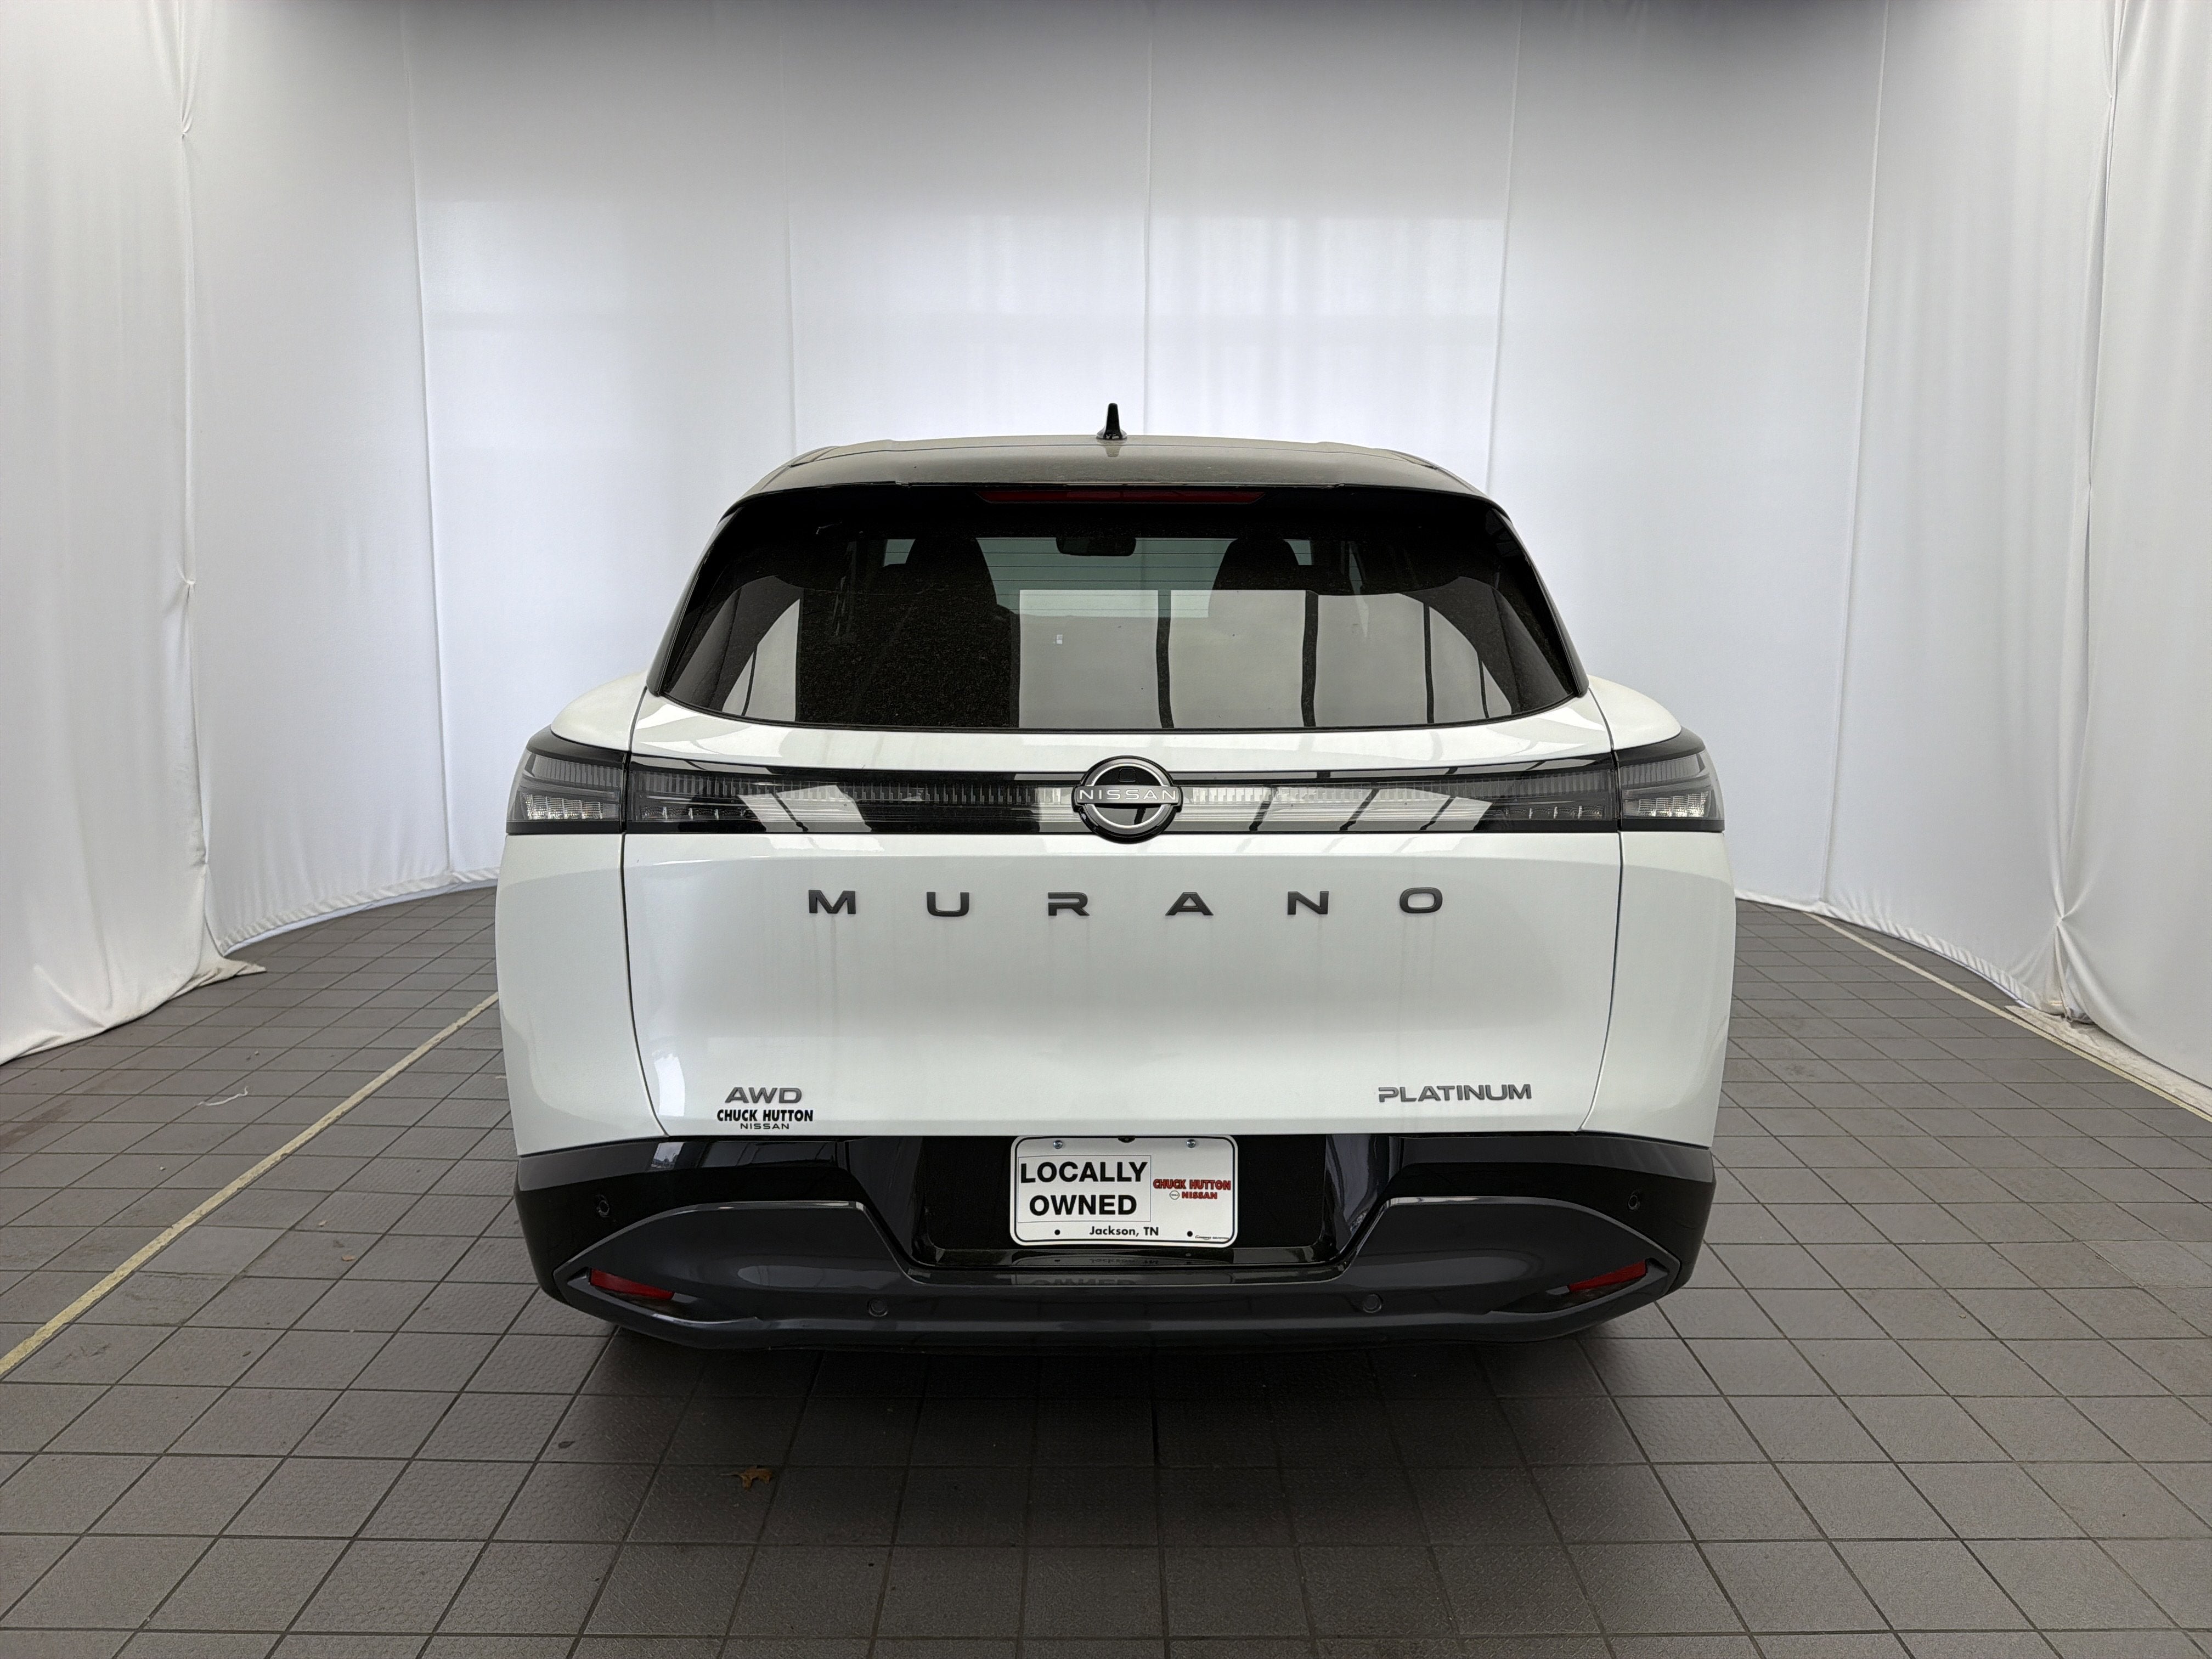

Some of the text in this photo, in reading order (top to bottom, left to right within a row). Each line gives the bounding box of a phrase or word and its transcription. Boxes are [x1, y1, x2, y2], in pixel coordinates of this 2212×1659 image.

[1079, 789, 1176, 800] NISSAN
[808, 887, 1443, 917] MURANO
[724, 1086, 803, 1104] AWD
[1378, 1084, 1532, 1103] PLATINUM
[716, 1109, 814, 1122] CHUCK HUTTON
[1020, 1161, 1148, 1183] LOCALLY
[1153, 1178, 1232, 1190] CHUCK HUTTON
[1181, 1191, 1218, 1200] NISSAN
[1029, 1194, 1137, 1216] OWNED
[1089, 1225, 1159, 1237] Jackson, TN
